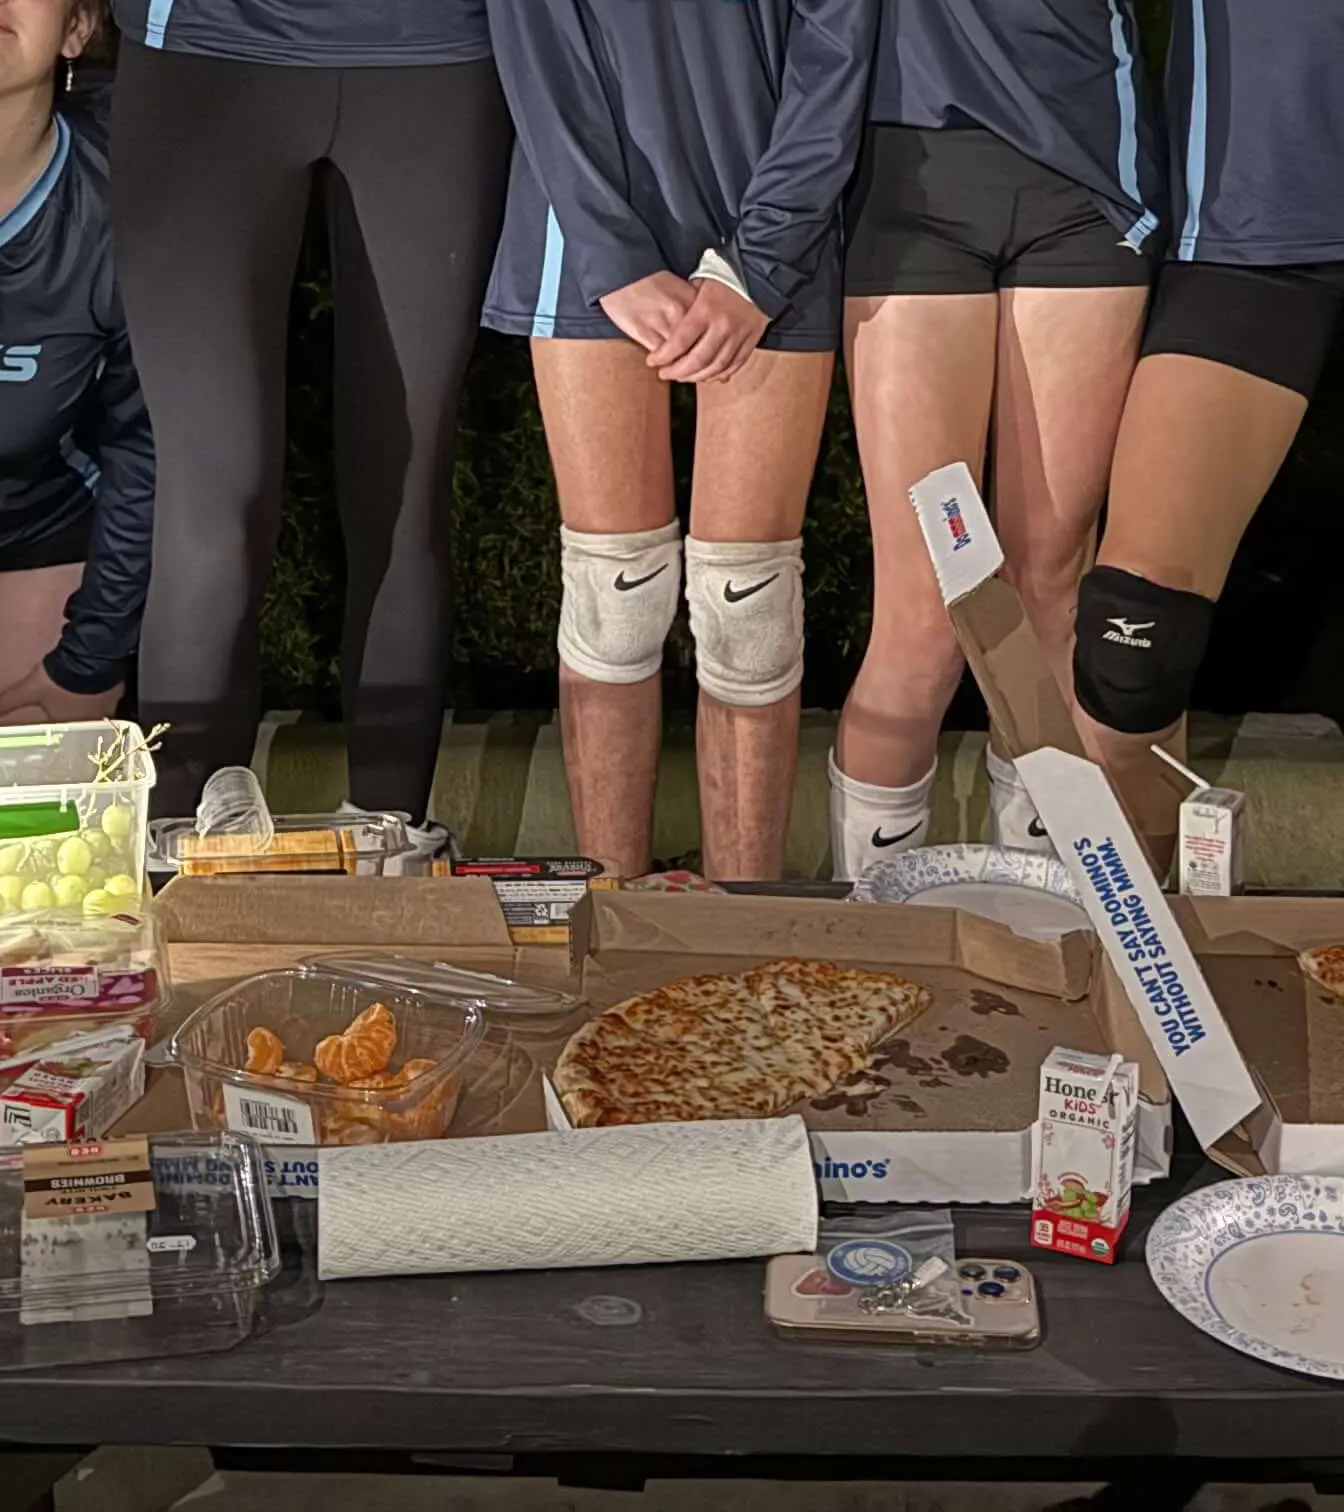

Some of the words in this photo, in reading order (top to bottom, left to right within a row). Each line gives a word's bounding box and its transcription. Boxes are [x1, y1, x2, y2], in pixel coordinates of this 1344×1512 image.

[1073, 836, 1129, 928] DOMINO'S
[1122, 894, 1166, 959] SAYING
[1116, 930, 1146, 963] SAY
[1134, 964, 1172, 1017] CAN'T
[1154, 961, 1207, 1044] WITHOUT
[1160, 1019, 1191, 1057] YOU
[1048, 1109, 1111, 1130] ORGANIC
[813, 1155, 889, 1179] ino's
[44, 1191, 133, 1206] BAKERY
